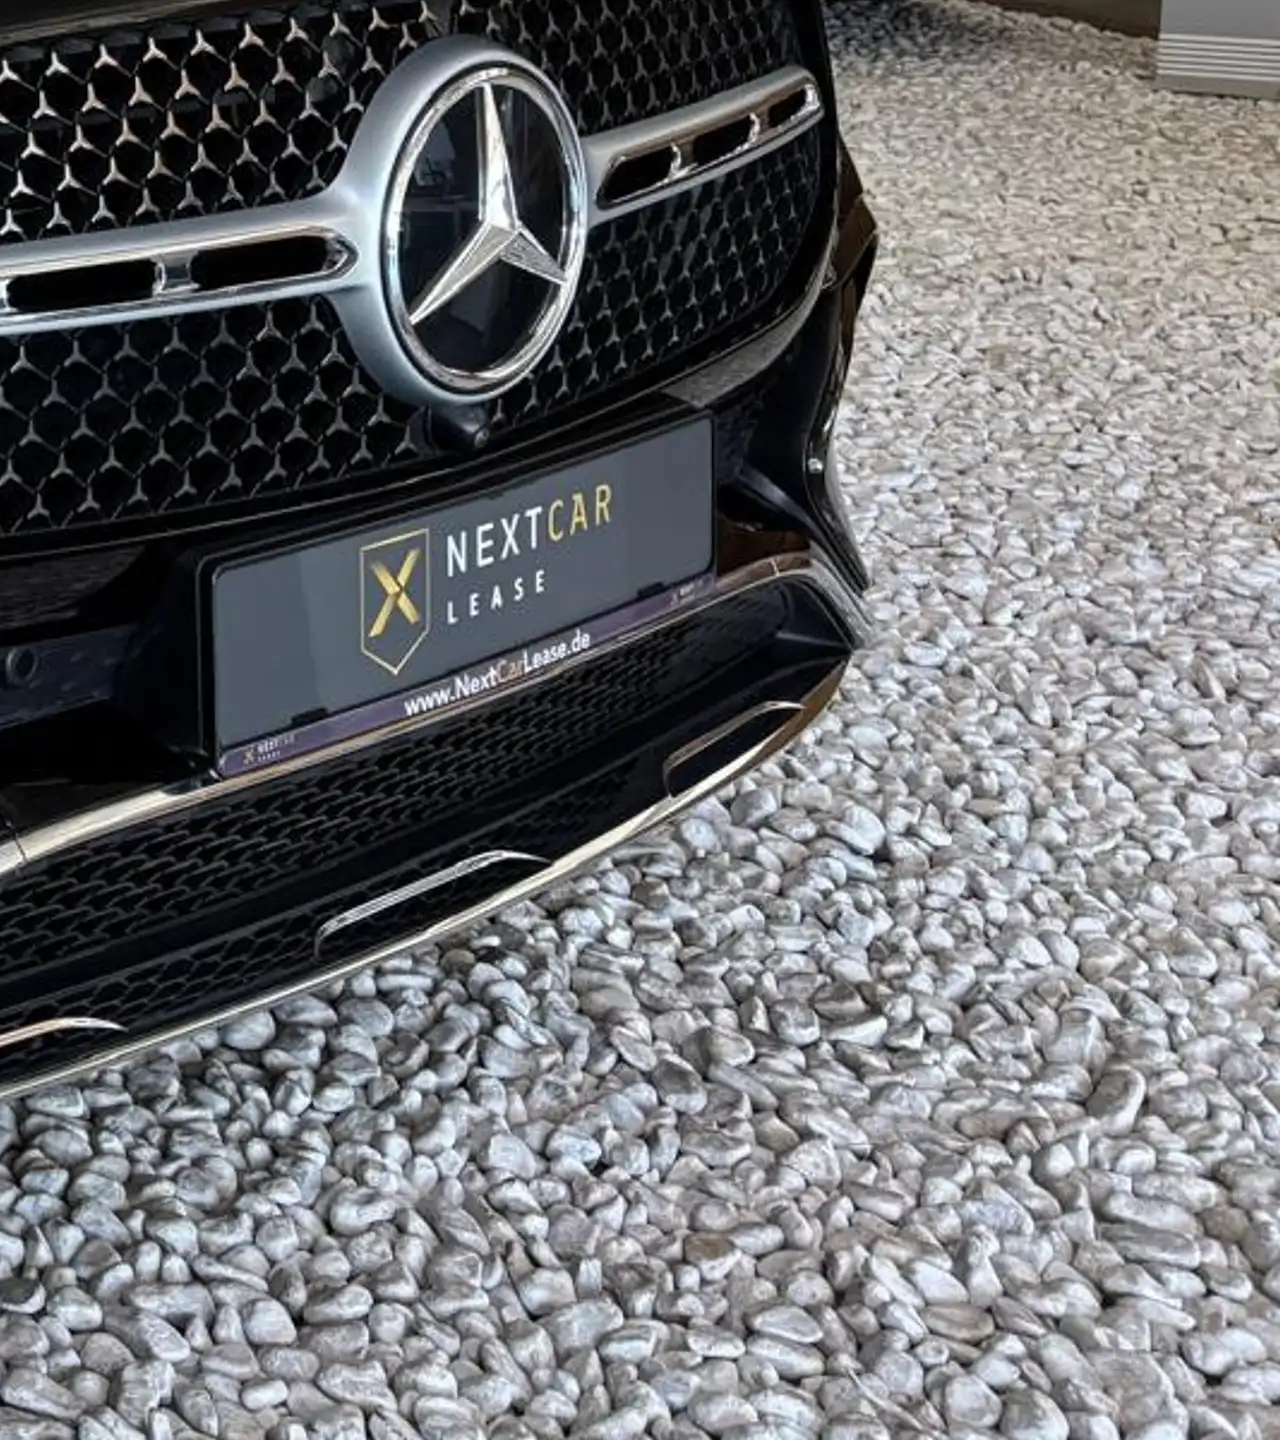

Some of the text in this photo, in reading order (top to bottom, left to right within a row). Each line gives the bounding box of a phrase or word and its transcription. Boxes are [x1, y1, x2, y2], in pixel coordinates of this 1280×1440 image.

[447, 483, 612, 578] NEXTCAR
[447, 568, 545, 625] LEASE
[404, 628, 591, 716] www.NextCarLease.de
